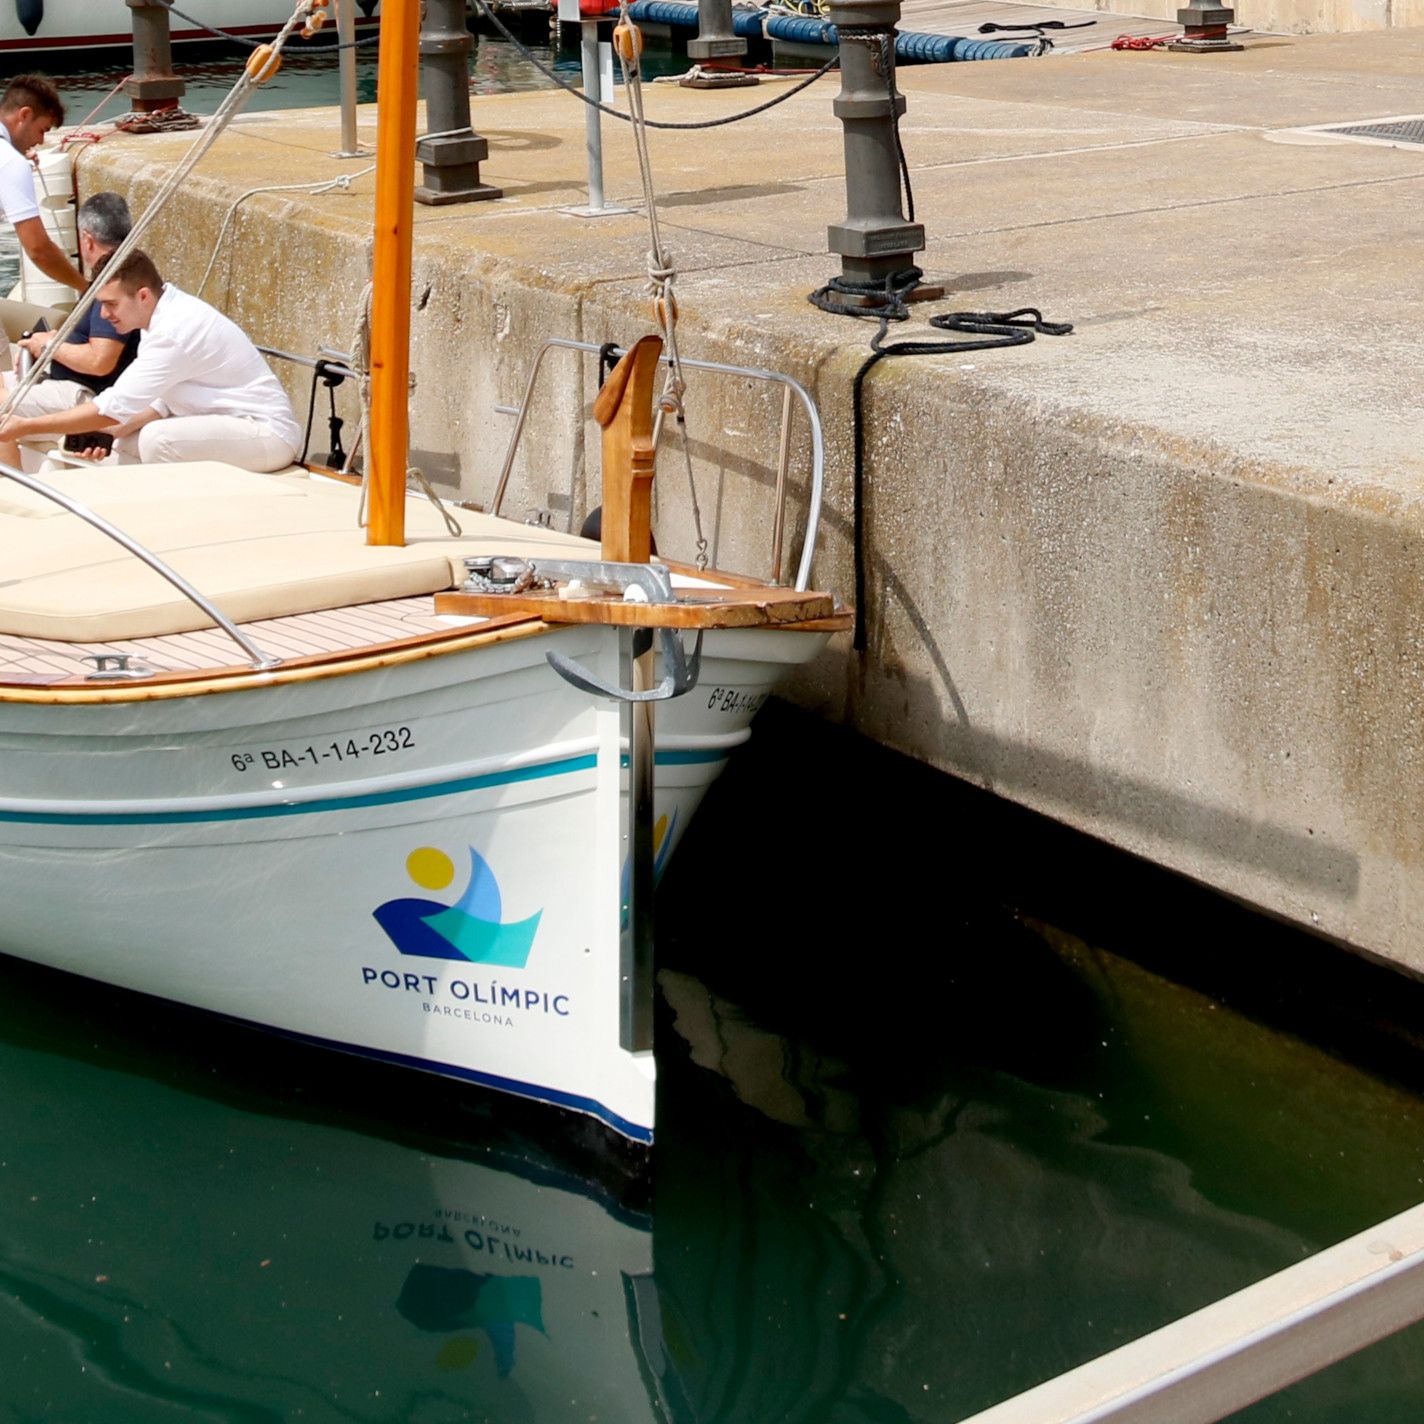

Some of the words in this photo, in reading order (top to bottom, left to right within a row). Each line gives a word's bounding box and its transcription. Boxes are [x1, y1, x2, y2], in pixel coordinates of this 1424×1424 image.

[231, 752, 255, 773] 6ª
[260, 726, 416, 771] BA-1-14-232
[361, 967, 438, 995] PORT
[450, 980, 570, 1016] OLÍMPIC
[422, 1002, 514, 1027] BARCELONA
